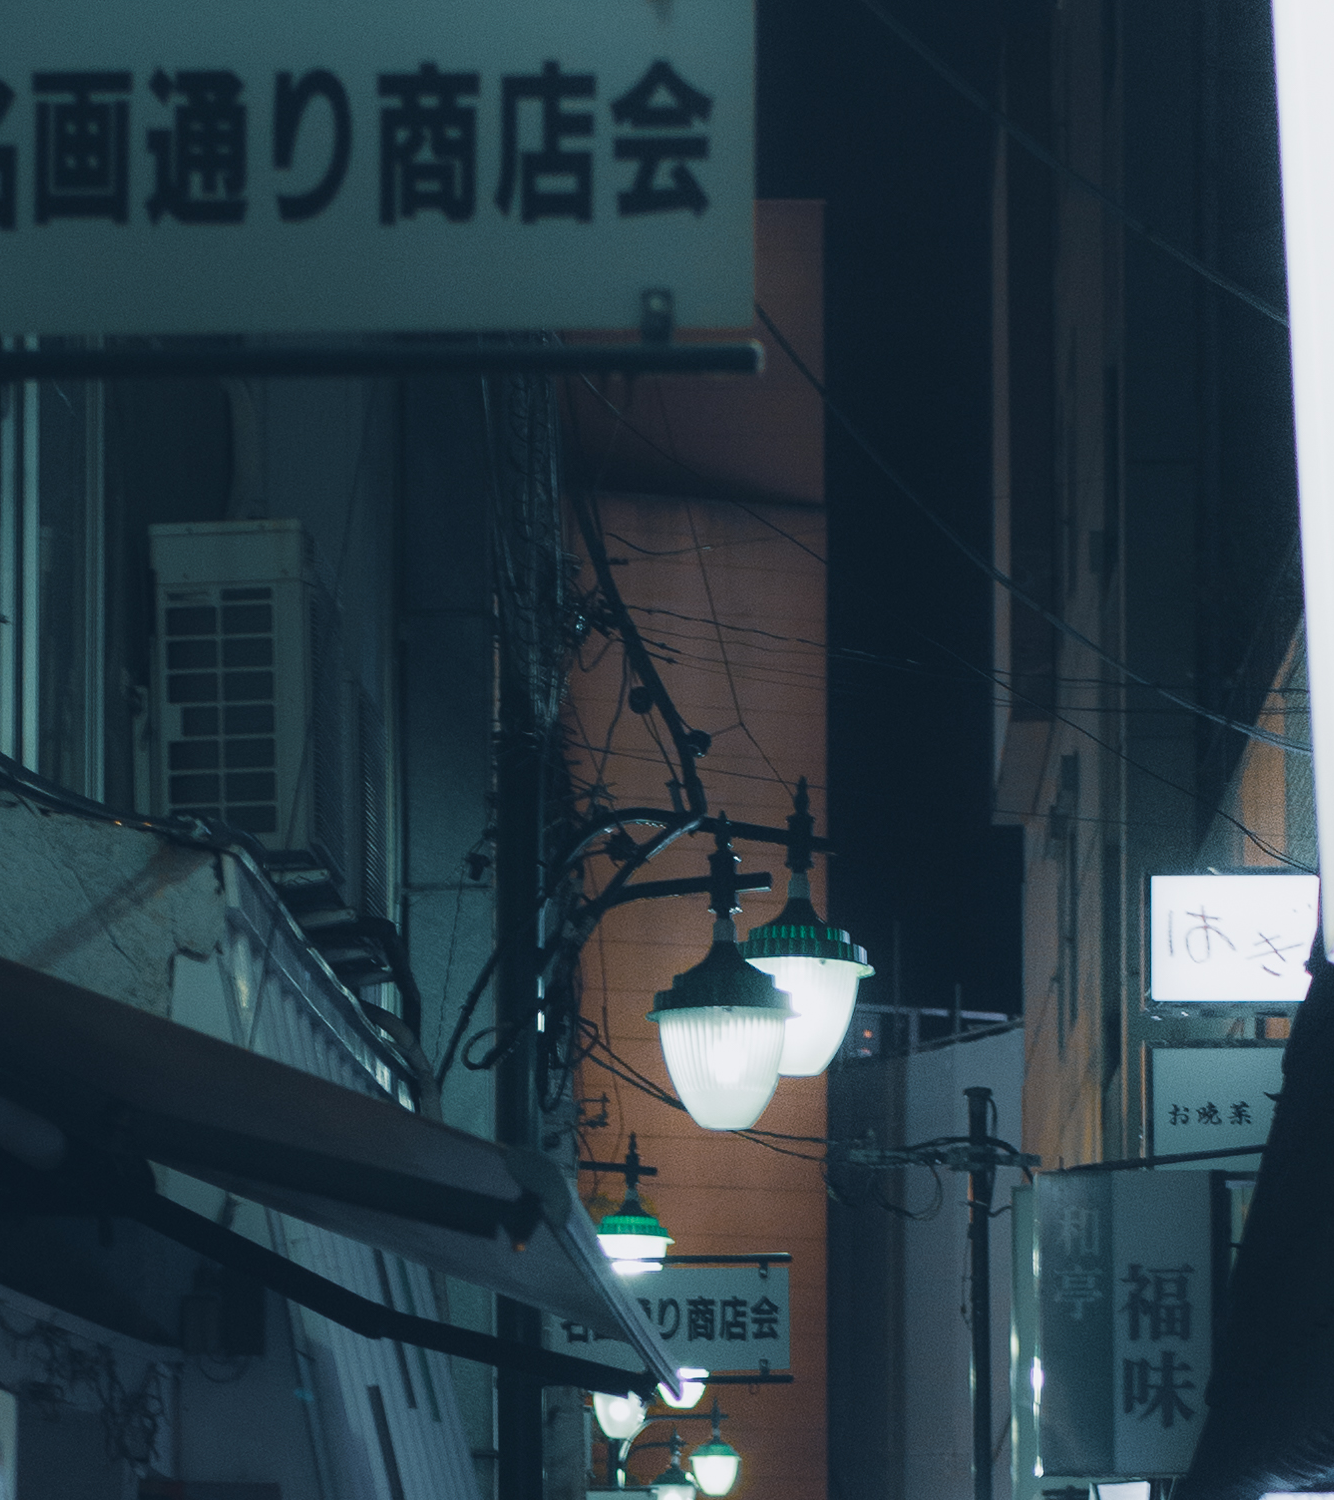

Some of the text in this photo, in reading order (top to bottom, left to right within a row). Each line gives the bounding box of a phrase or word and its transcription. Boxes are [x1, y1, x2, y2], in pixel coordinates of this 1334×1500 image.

[560, 1296, 779, 1343] り商店会
[1119, 1262, 1197, 1431] 福味
